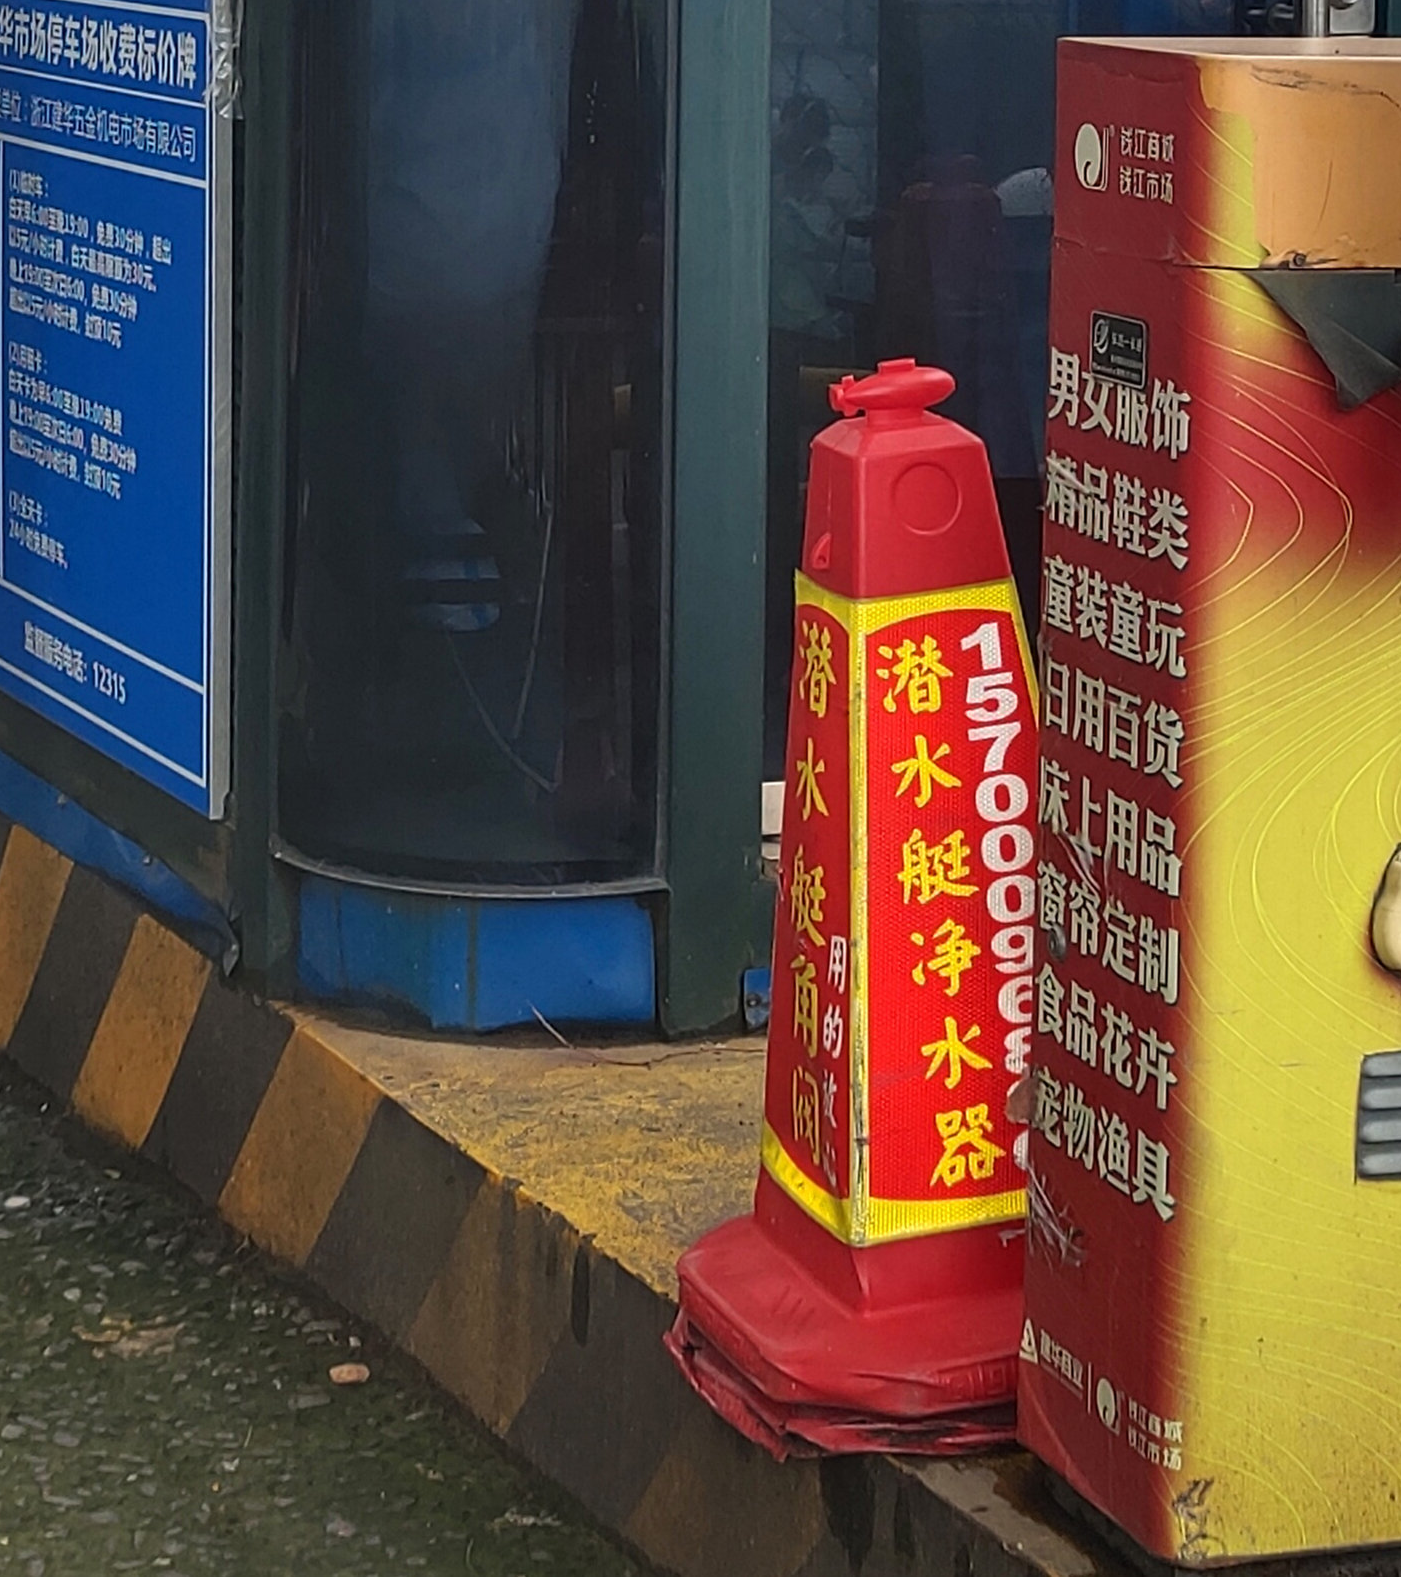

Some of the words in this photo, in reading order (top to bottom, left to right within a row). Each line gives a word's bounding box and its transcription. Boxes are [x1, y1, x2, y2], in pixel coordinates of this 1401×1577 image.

[1047, 345, 1192, 461] 男女服饰
[1045, 450, 1190, 571] 精品鞋类
[1043, 554, 1188, 679] 童装童玩
[1044, 656, 1186, 789] 日用百货
[789, 619, 837, 1167] 潜水艇角阀
[1038, 755, 1182, 898] 床上用品
[876, 633, 1007, 1188] 潜水艇净水器
[1036, 859, 1180, 1005] 窗帘定制
[1034, 962, 1179, 1110] 食品花卉
[1033, 1066, 1177, 1222] 宠物渔具
